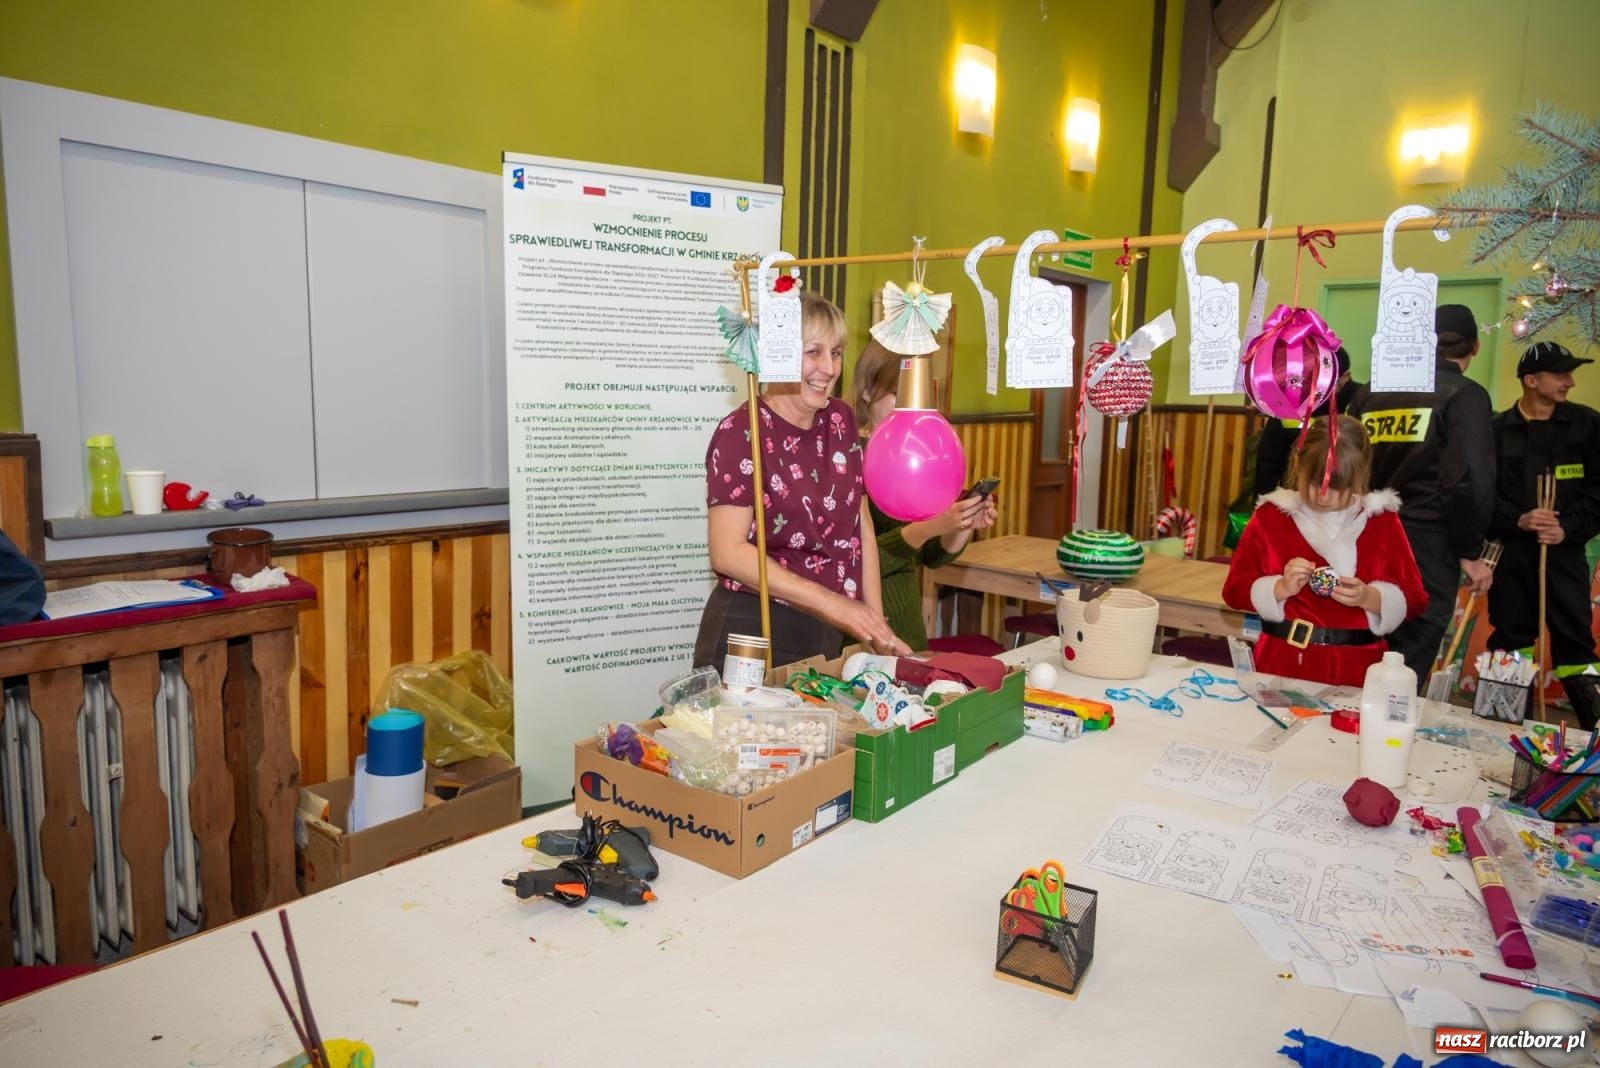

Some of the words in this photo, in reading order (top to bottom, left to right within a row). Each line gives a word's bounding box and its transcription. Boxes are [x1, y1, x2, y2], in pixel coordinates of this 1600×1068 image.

[632, 214, 662, 224] PROJEKT
[593, 222, 662, 240] WZMOCNIENIE
[665, 231, 708, 243] PROCESU
[508, 234, 593, 250] SPRAWIEDLIWEJ
[595, 240, 675, 258] TRANSFORMACJI
[676, 248, 687, 257] W
[689, 249, 720, 261] GMINIE
[564, 382, 600, 391] PROJEKT
[603, 383, 644, 392] OBEJMUJE
[646, 384, 697, 394] NASTĘPUJĄCE
[558, 402, 605, 410] AKTYWNOŚCI
[570, 465, 610, 473] DOTYCZĄCE
[564, 548, 614, 558] MIESZKAŃCÓW
[616, 544, 675, 554] UCZESTNICZĄCYCH
[580, 604, 624, 613] KRZANOWICE
[546, 654, 590, 665] CAŁKOWITA
[592, 648, 628, 659] WARTOŚĆ
[630, 645, 666, 656] PROJEKTU
[668, 642, 696, 651] WYNOS
[564, 662, 601, 673] WARTOŚĆ
[602, 656, 668, 670] DOFINANSOWANIA
[580, 771, 735, 846] Champion
